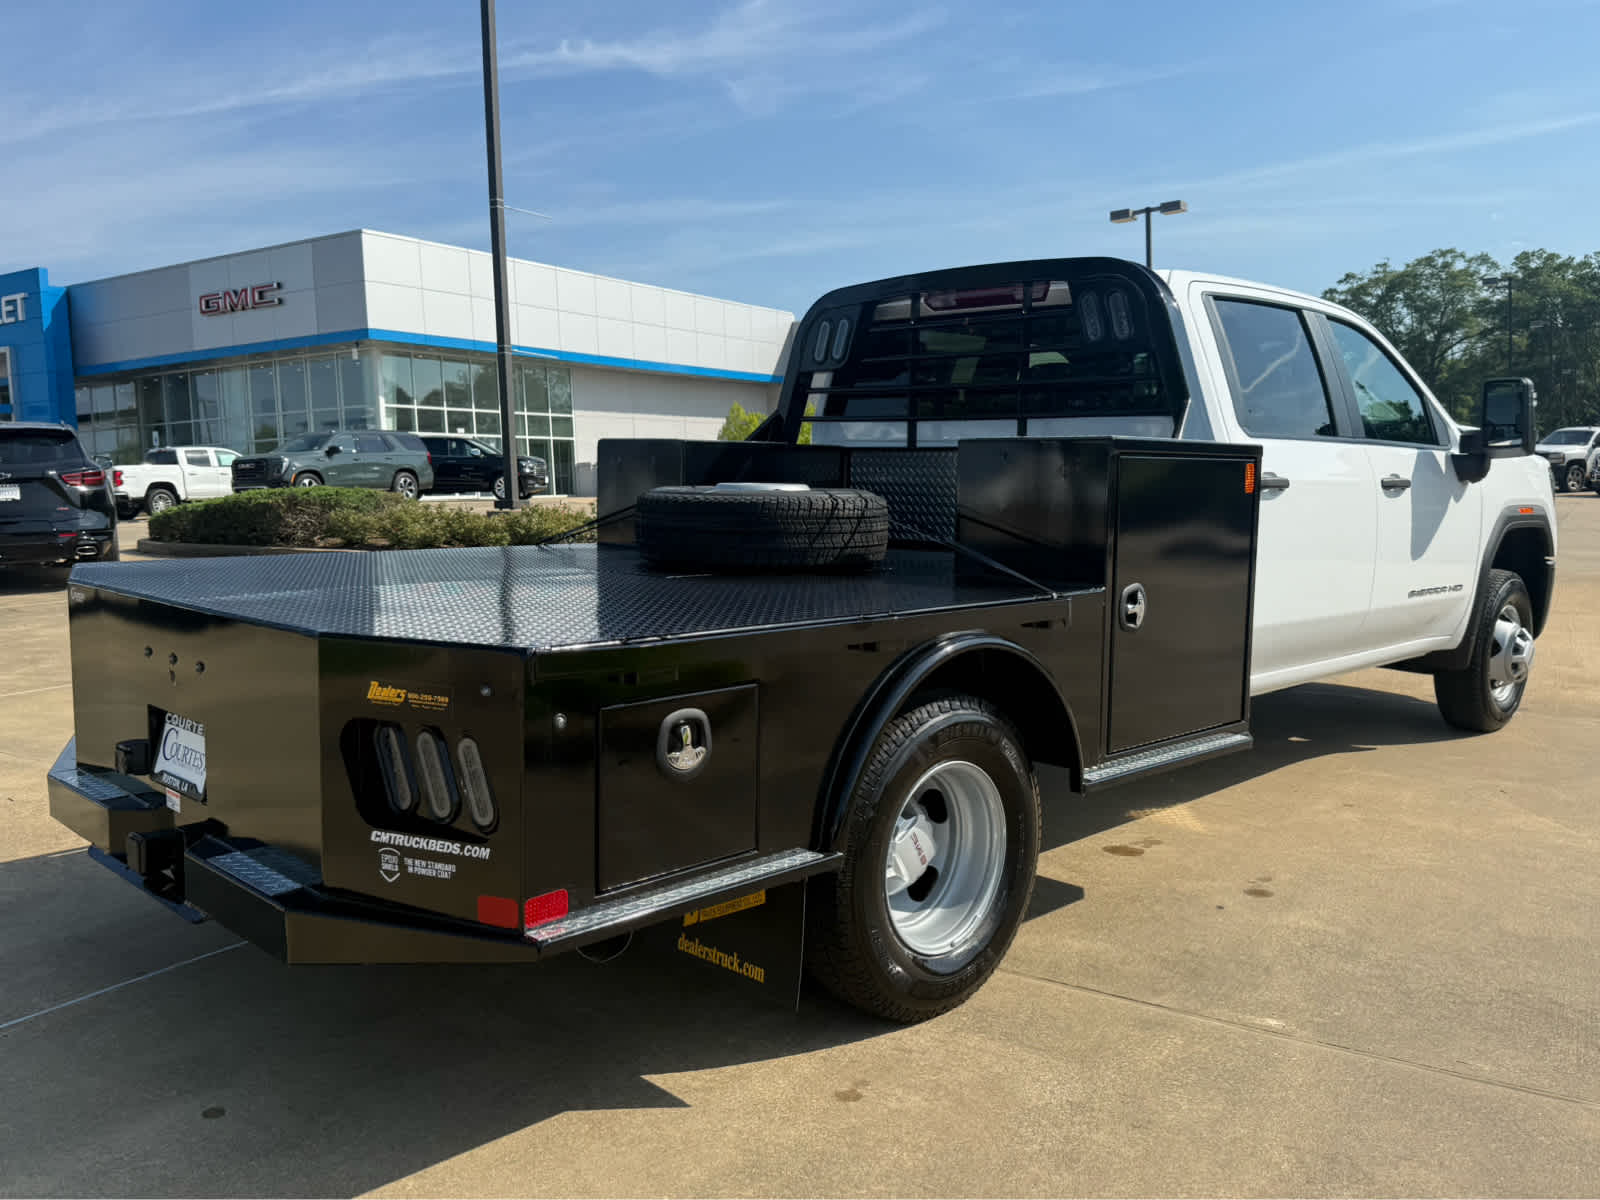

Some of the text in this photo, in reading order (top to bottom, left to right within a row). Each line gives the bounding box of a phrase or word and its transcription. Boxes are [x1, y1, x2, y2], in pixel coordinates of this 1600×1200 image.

[0, 292, 29, 325] ET
[200, 281, 283, 316] GMC
[367, 681, 408, 703] Dealers
[370, 830, 490, 860] CMTRUCKBEDS.COM
[414, 859, 425, 869] NEW
[427, 861, 456, 873] STANDARD
[414, 866, 436, 877] POWDER
[438, 869, 452, 879] COAT
[677, 933, 765, 984] dealerstruck.com
